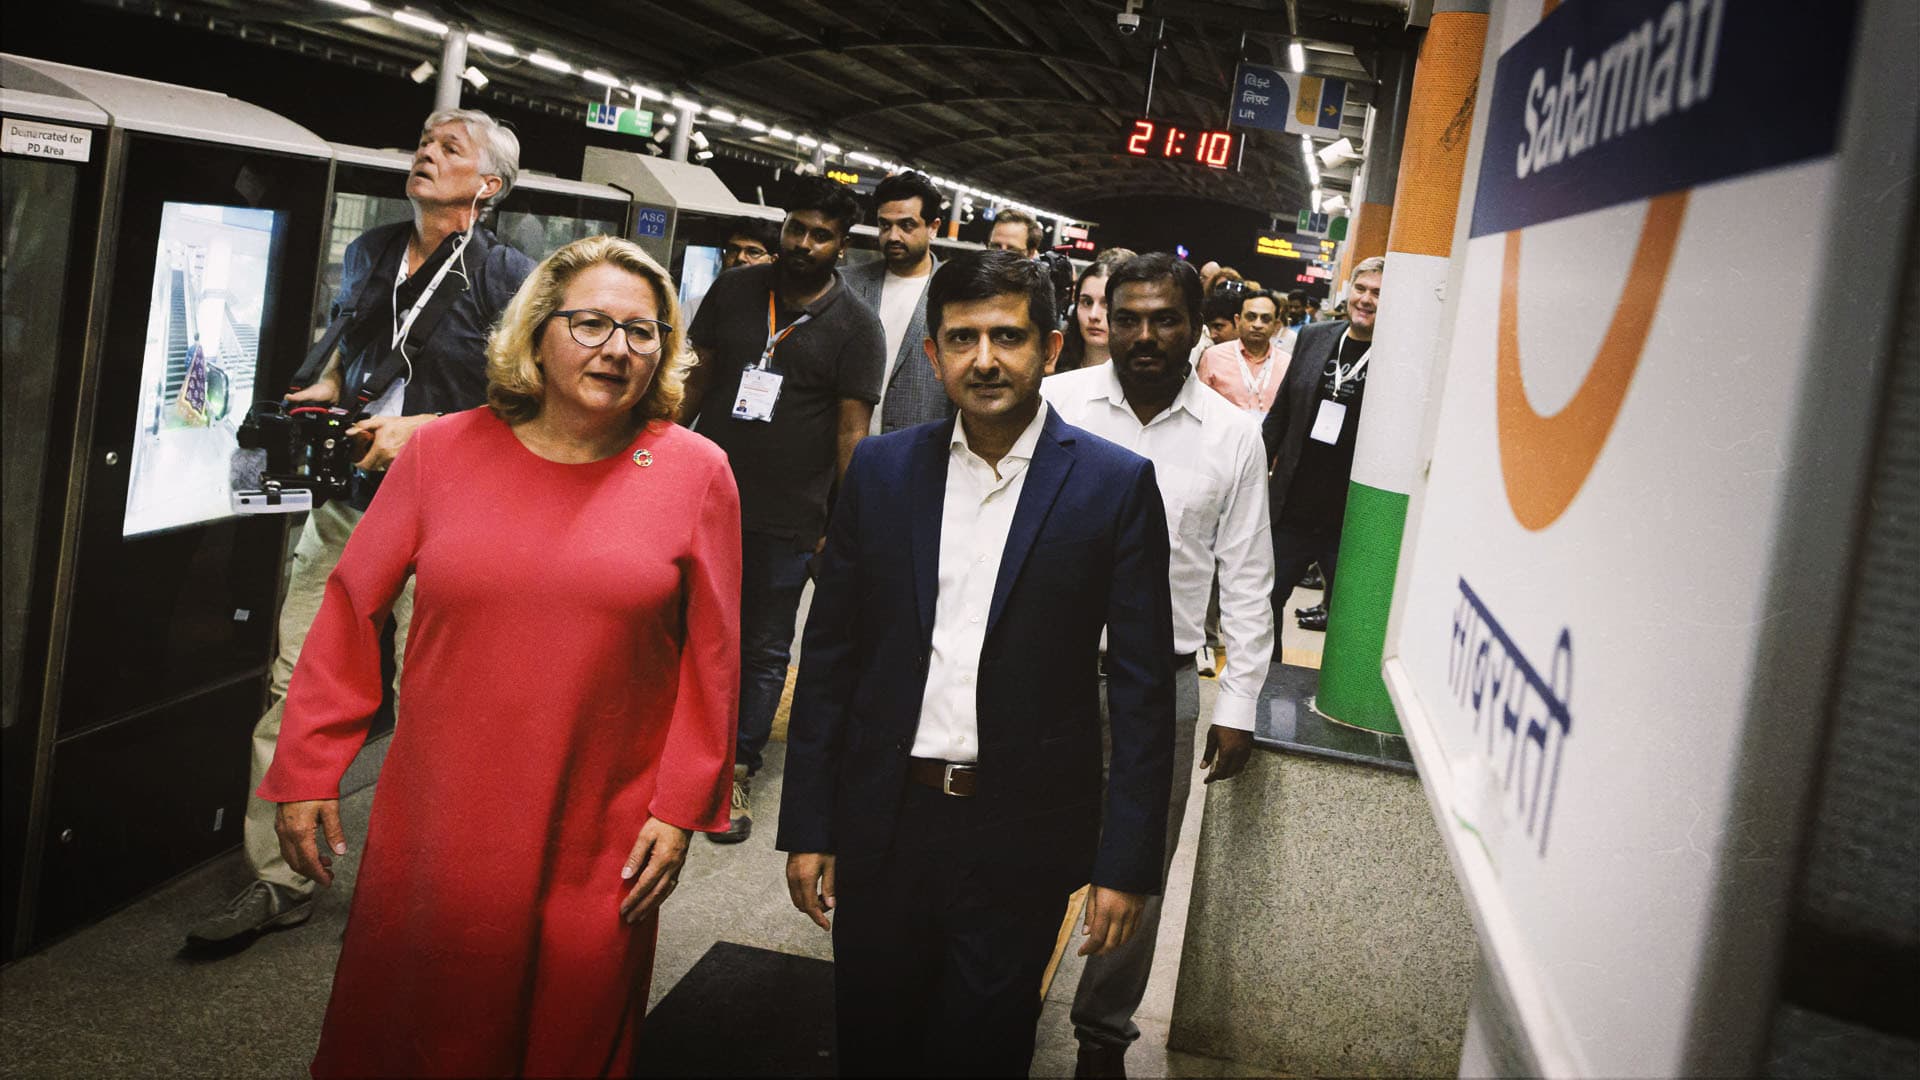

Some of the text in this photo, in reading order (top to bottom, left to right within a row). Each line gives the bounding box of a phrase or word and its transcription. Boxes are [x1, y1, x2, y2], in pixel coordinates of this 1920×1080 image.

[1516, 0, 1725, 179] Sabarmati
[1239, 109, 1256, 120] Lift
[70, 134, 84, 144] for
[1128, 121, 1232, 165] 21:10
[27, 142, 65, 156] PD Area
[641, 211, 665, 224] ASG
[647, 224, 658, 234] 12
